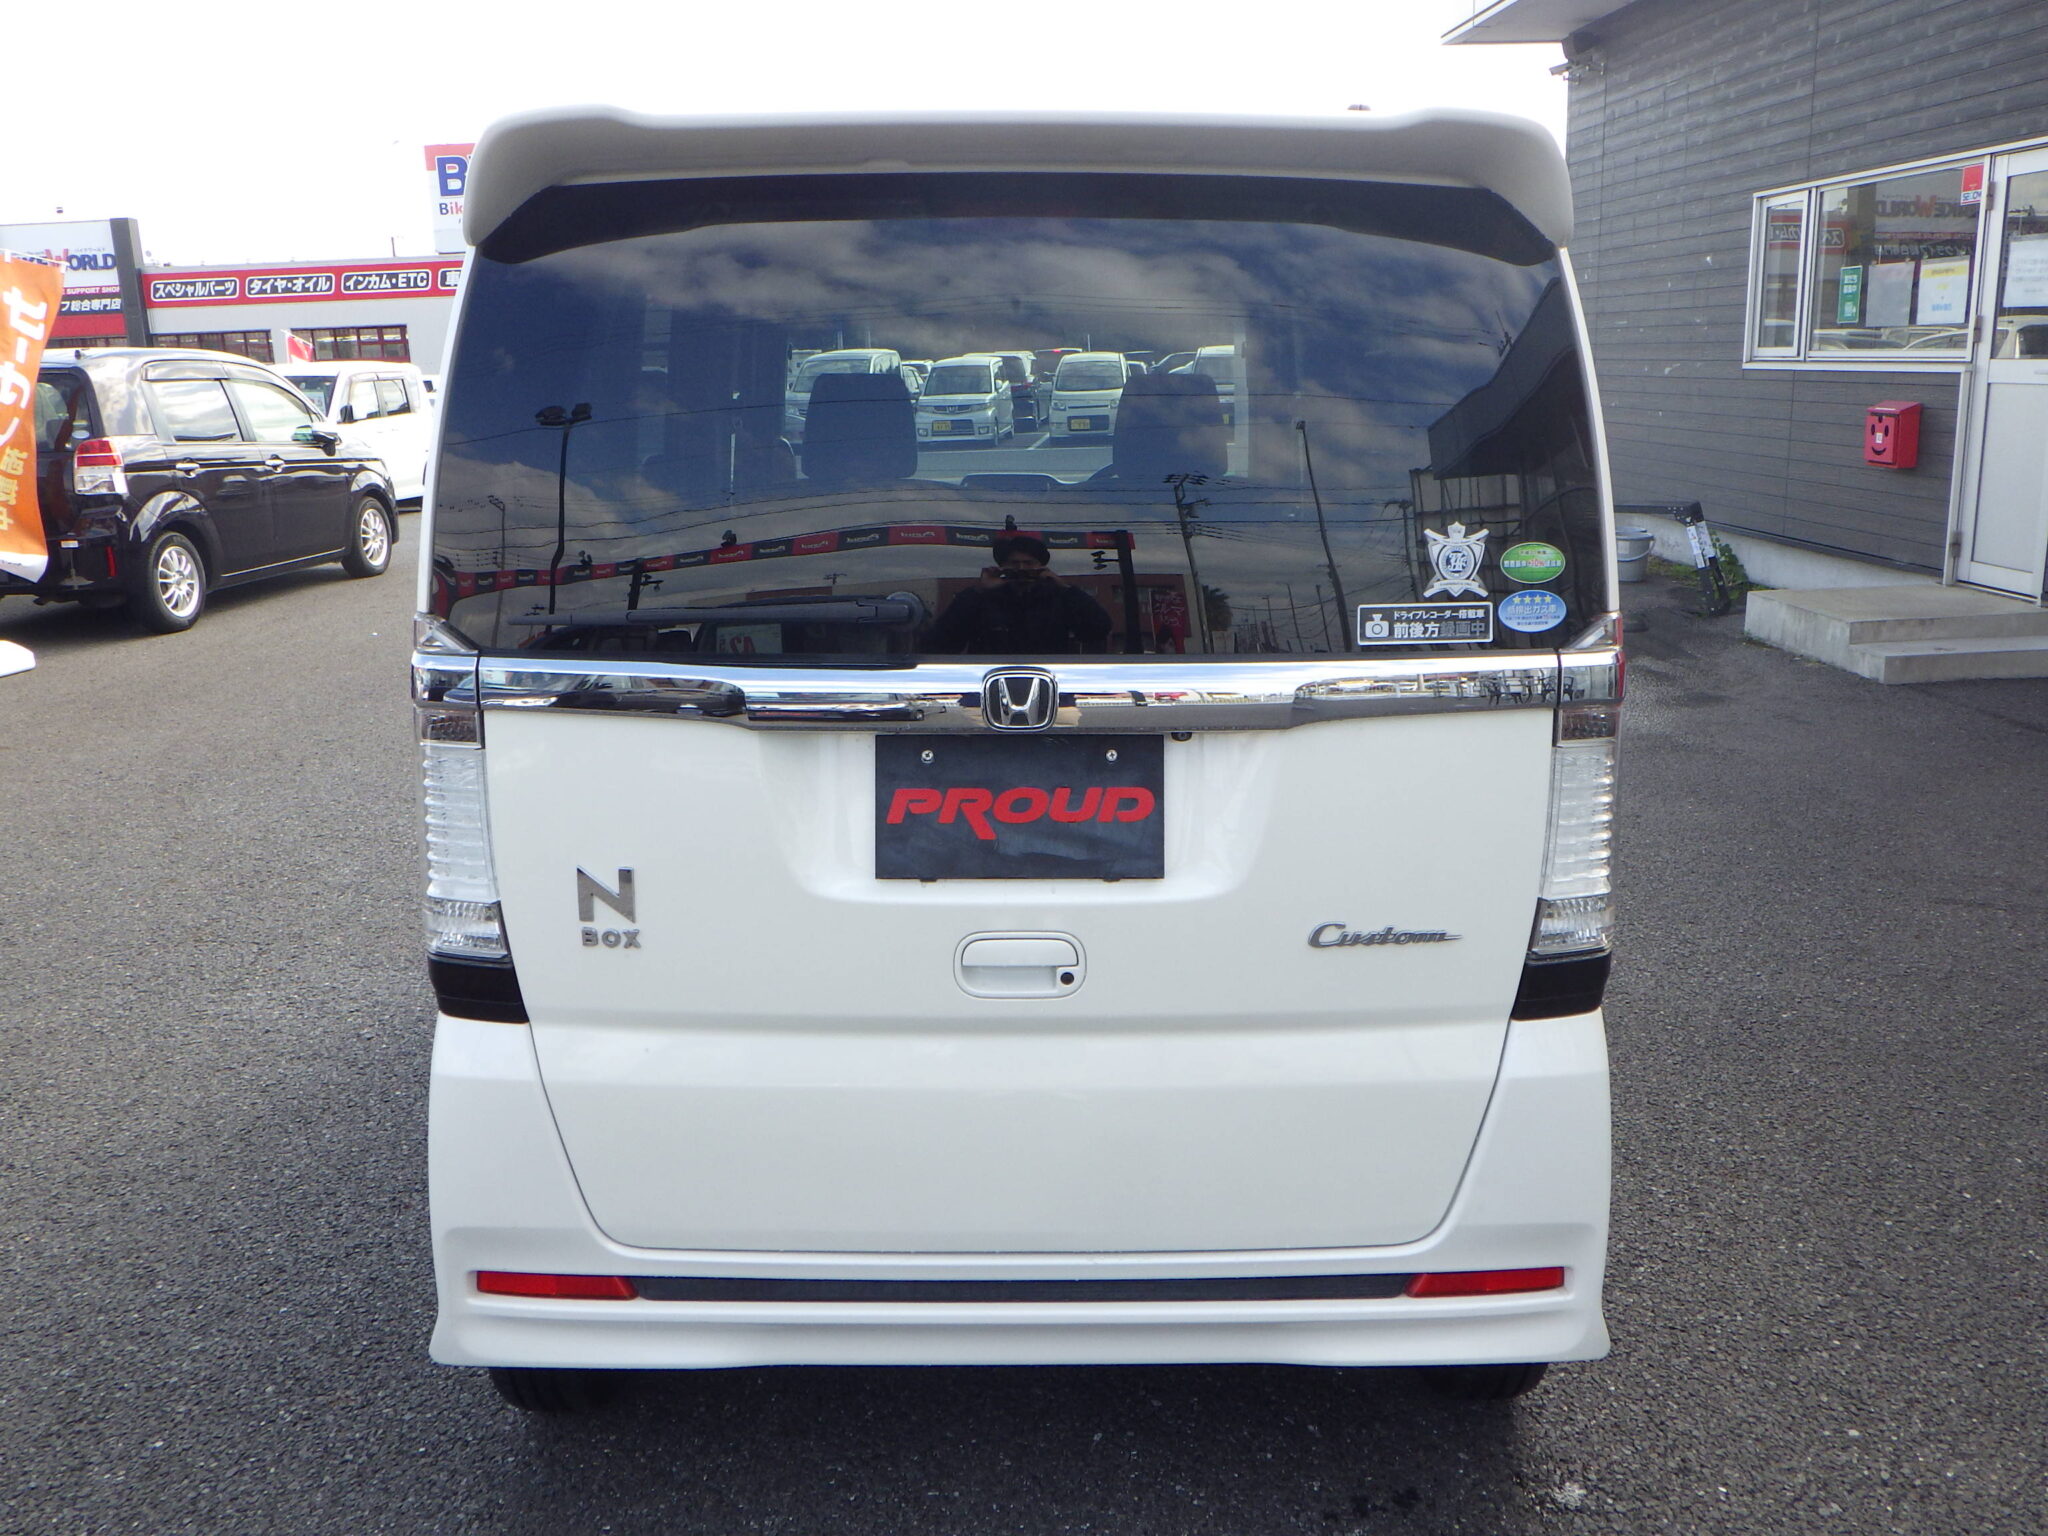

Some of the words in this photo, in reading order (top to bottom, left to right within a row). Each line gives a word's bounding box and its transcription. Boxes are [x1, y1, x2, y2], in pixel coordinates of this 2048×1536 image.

[155, 280, 235, 298] スペシャルパーツ
[249, 276, 330, 294] タイヤ・オイル
[886, 787, 1155, 840] PROUD
[576, 865, 636, 924] N
[581, 926, 642, 949] BOX
[1308, 921, 1463, 949] Custom
